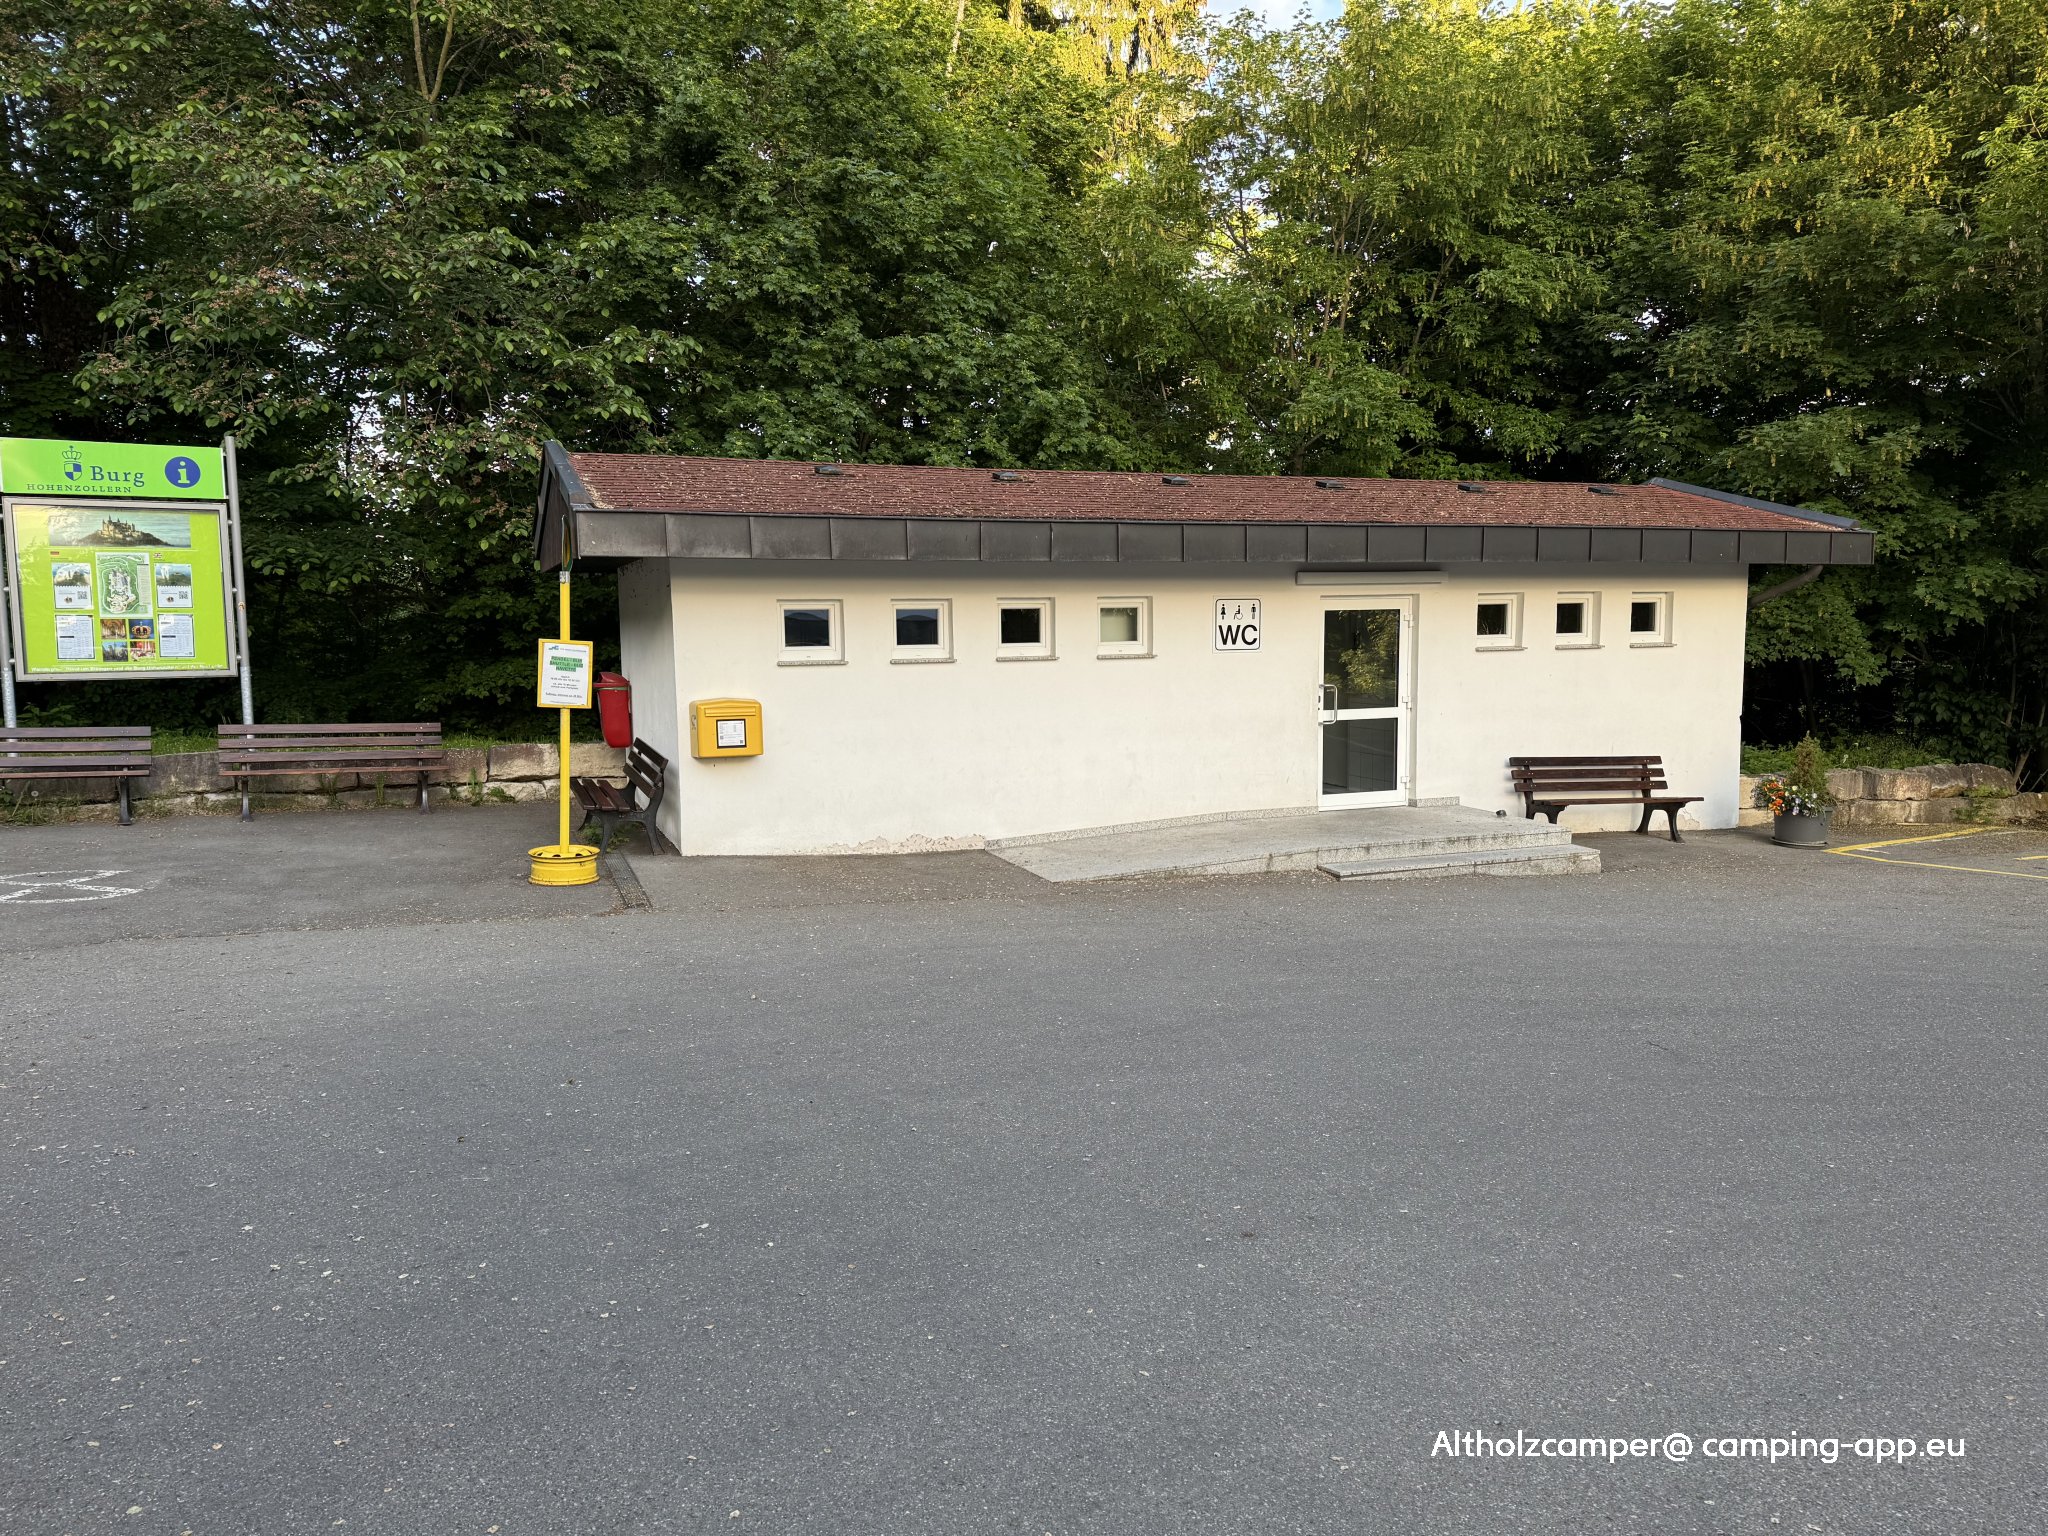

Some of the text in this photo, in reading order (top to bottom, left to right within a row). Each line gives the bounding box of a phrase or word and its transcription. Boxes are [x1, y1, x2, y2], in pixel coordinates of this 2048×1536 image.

[90, 465, 145, 488] Burg
[26, 483, 132, 494] HOHENZOLLERN
[1218, 624, 1258, 646] WC
